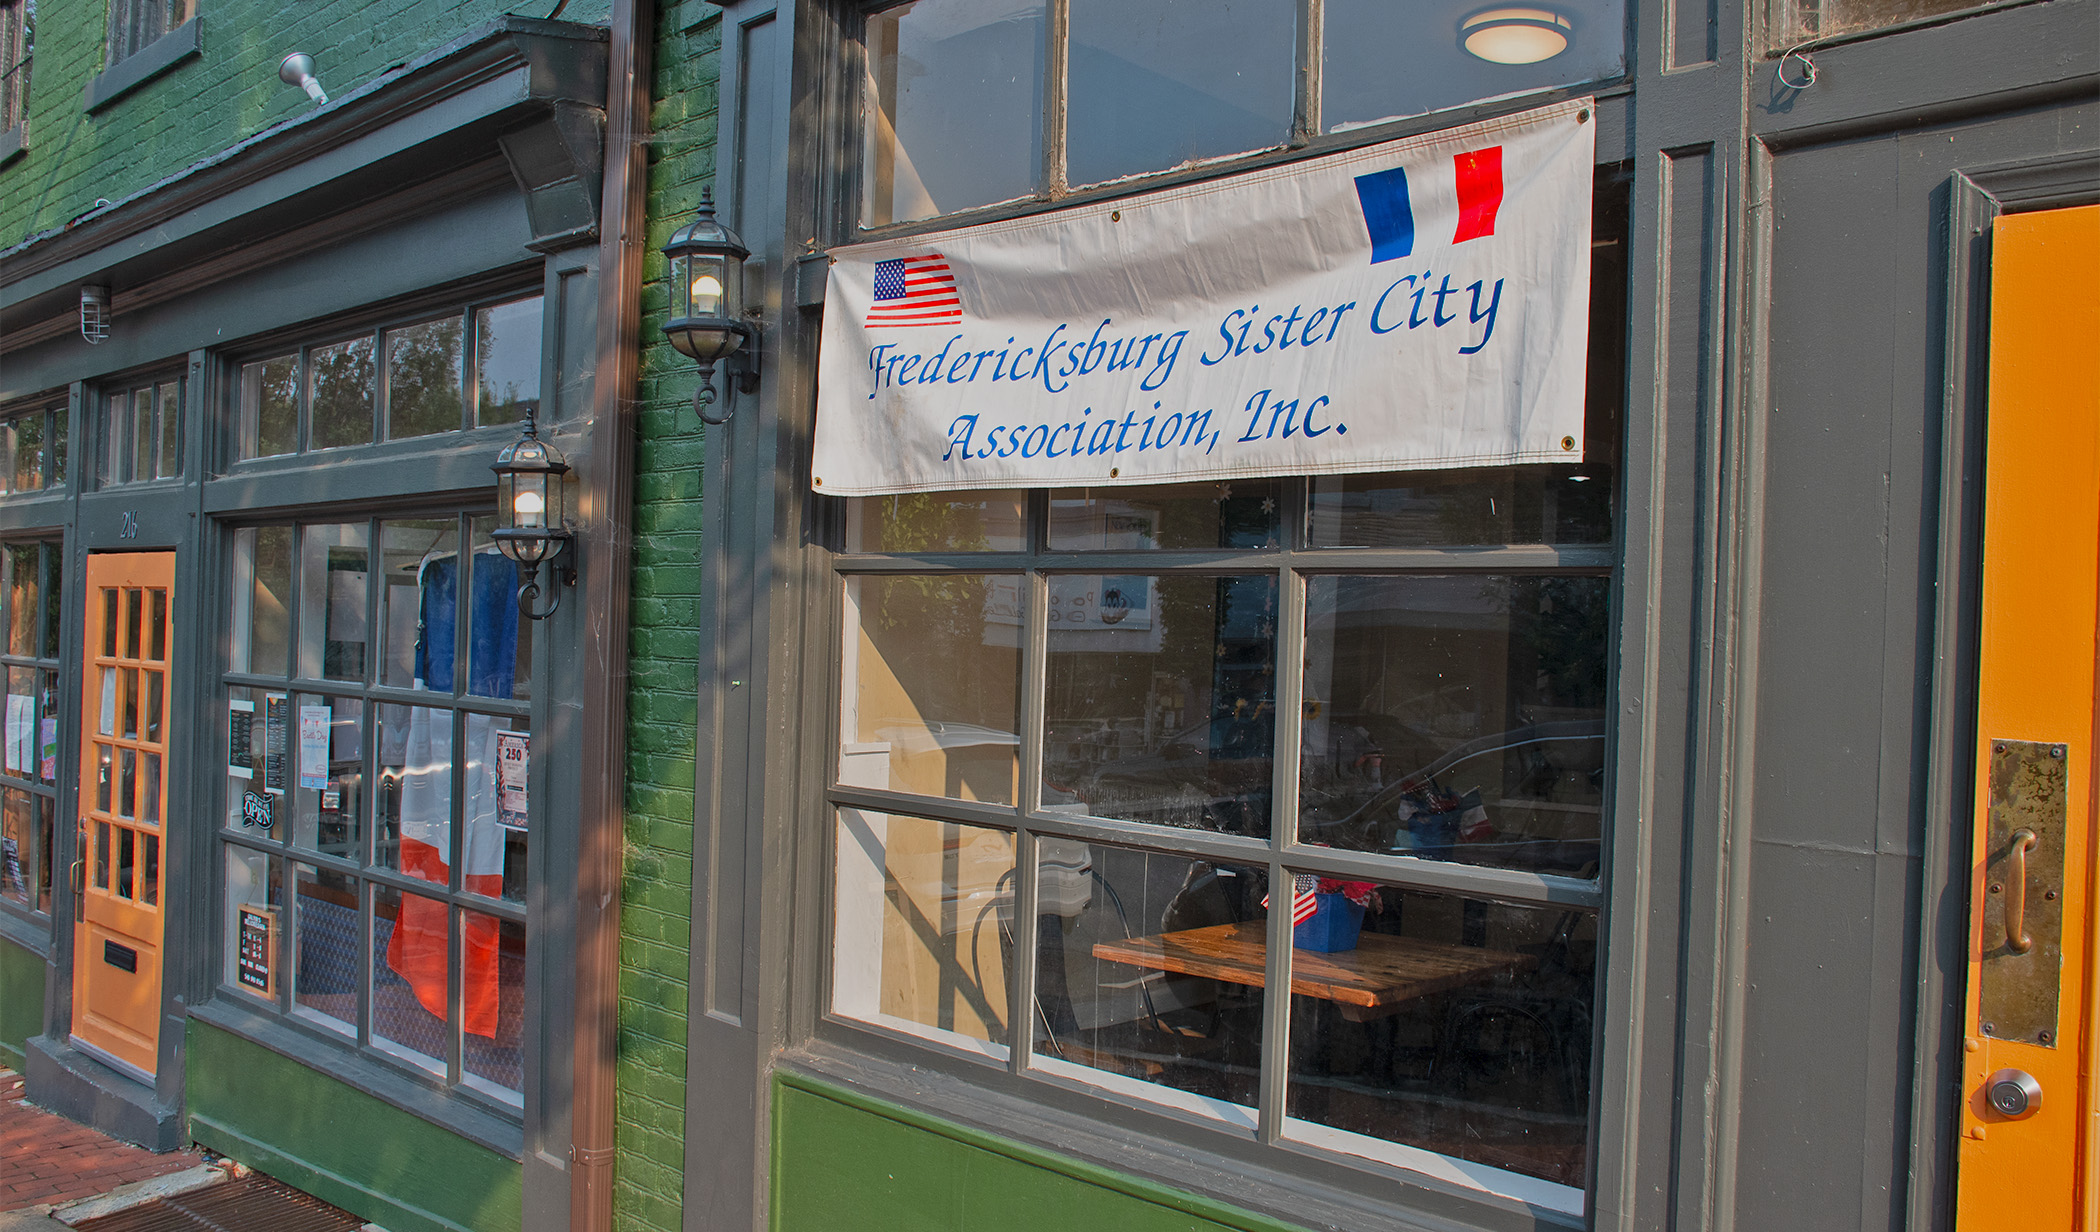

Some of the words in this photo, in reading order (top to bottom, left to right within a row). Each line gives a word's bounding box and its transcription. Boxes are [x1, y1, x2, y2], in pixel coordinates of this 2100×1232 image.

[868, 318, 1190, 400] Fredericksburg
[1200, 301, 1357, 366] Sister
[1370, 269, 1505, 355] City
[942, 400, 1221, 462] Association,
[1237, 389, 1348, 443] Inc.
[120, 510, 138, 539] 216
[505, 747, 522, 761] 250
[244, 800, 271, 825] OPEN
